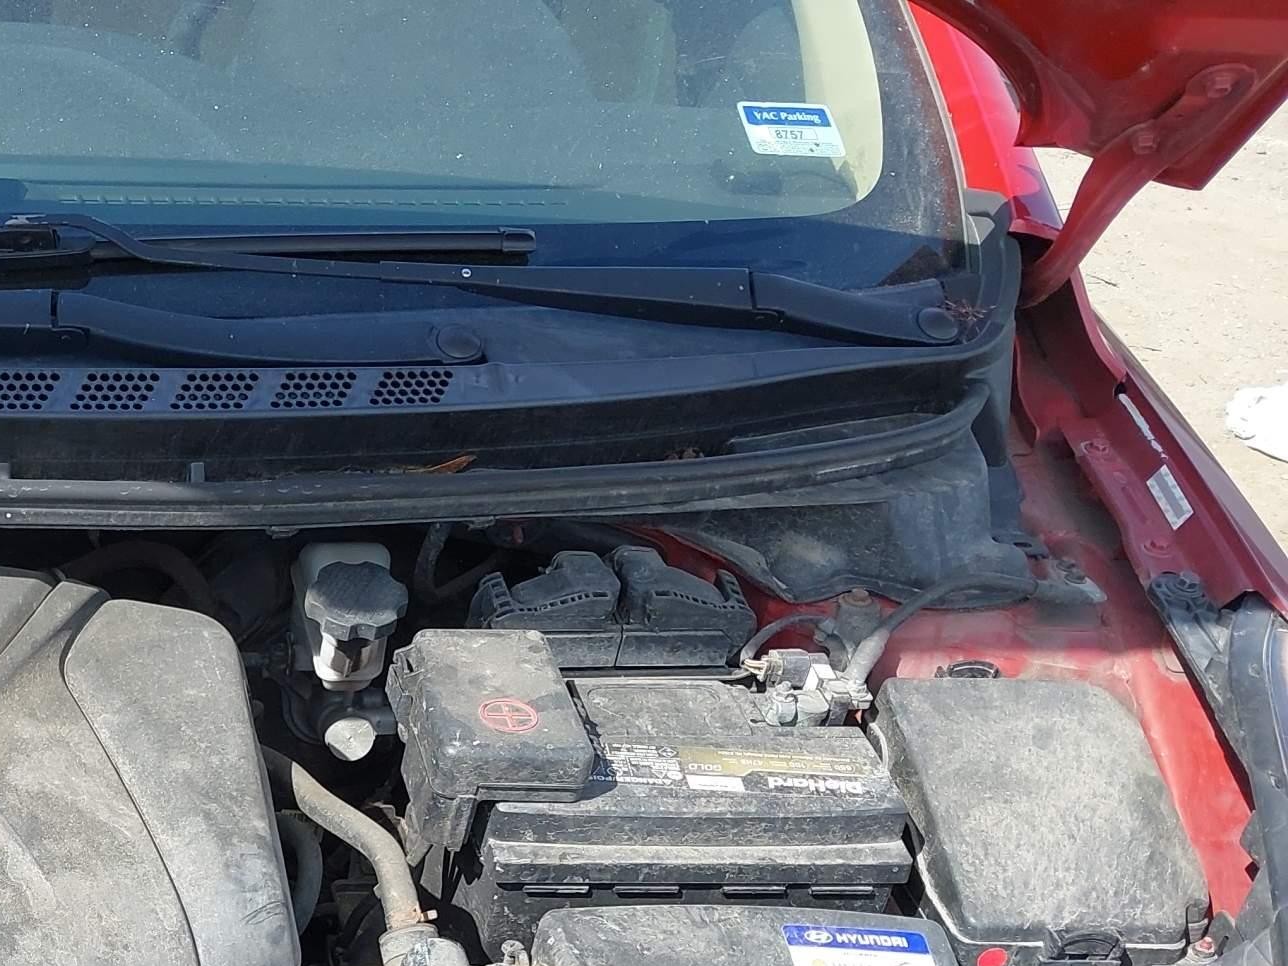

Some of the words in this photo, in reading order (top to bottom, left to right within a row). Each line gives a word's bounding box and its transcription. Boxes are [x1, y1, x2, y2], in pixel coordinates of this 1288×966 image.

[780, 112, 822, 124] Parking
[775, 129, 805, 140] 8757
[688, 762, 723, 772] GOLD
[767, 775, 863, 795] DieHard
[836, 932, 909, 948] HYUNDAI
